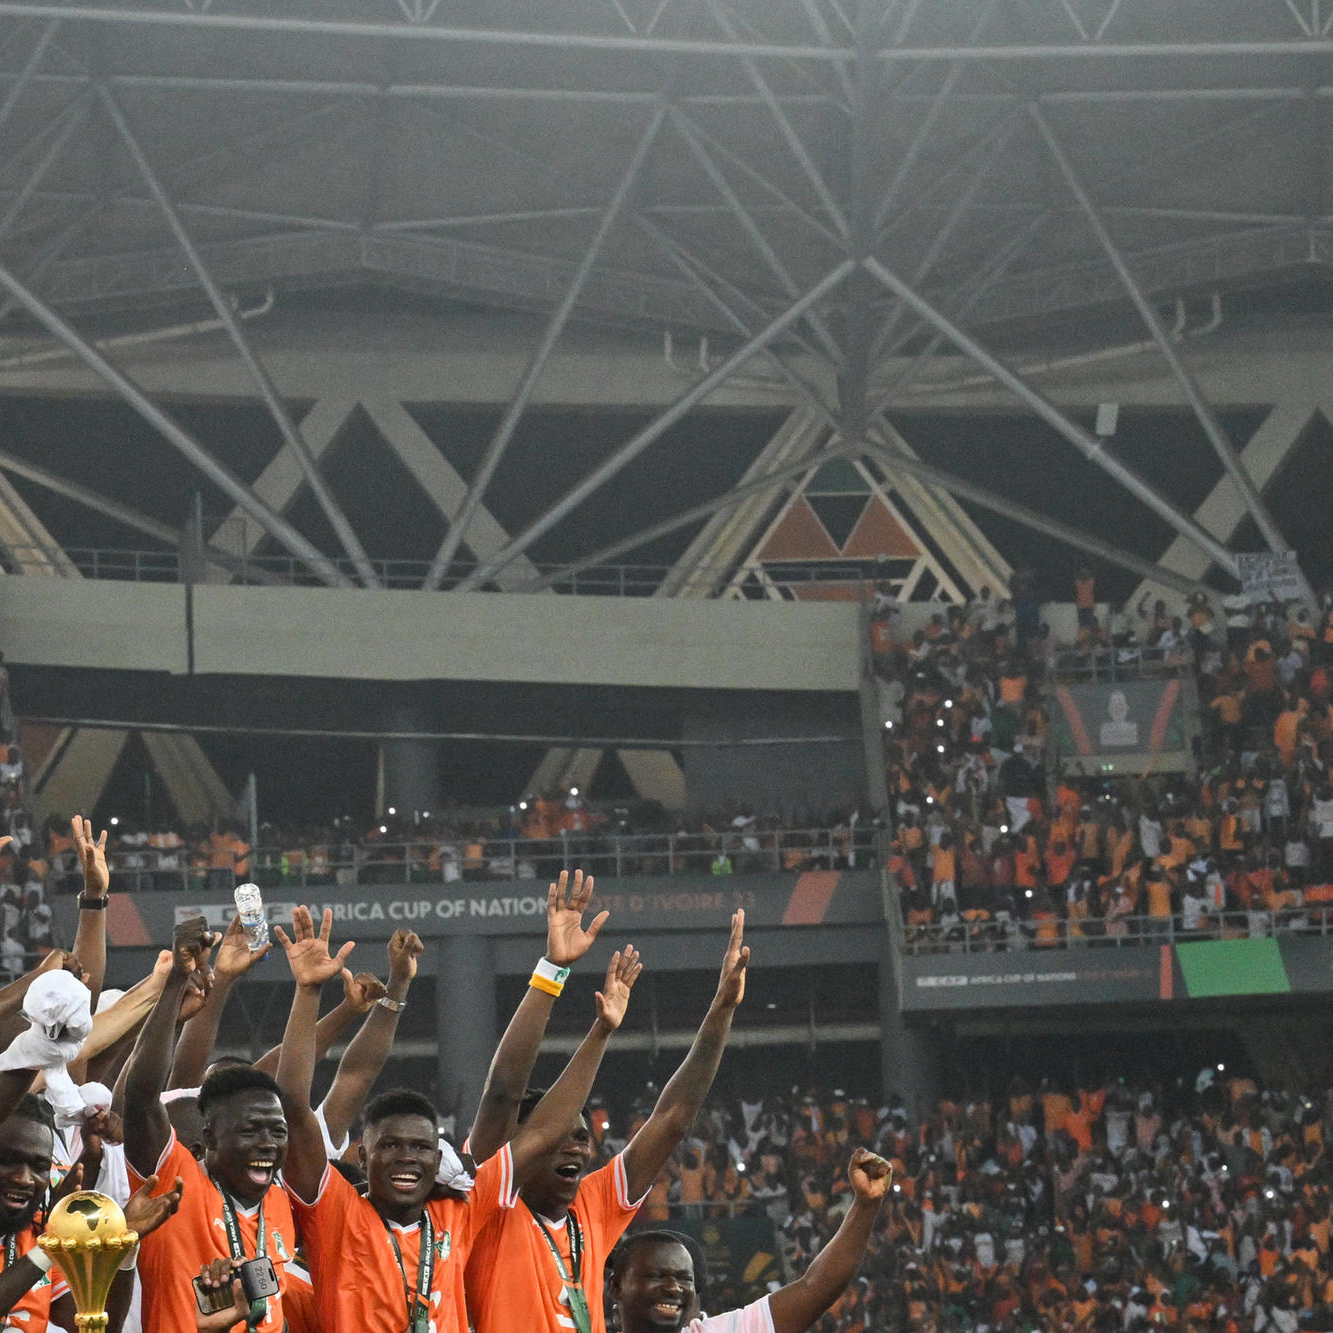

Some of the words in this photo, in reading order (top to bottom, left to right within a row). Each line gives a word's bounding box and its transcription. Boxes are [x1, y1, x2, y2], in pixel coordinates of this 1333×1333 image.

[389, 901, 432, 921] CUP
[436, 899, 465, 918] OF
[470, 897, 548, 917] NATION
[225, 1210, 233, 1222] CUP
